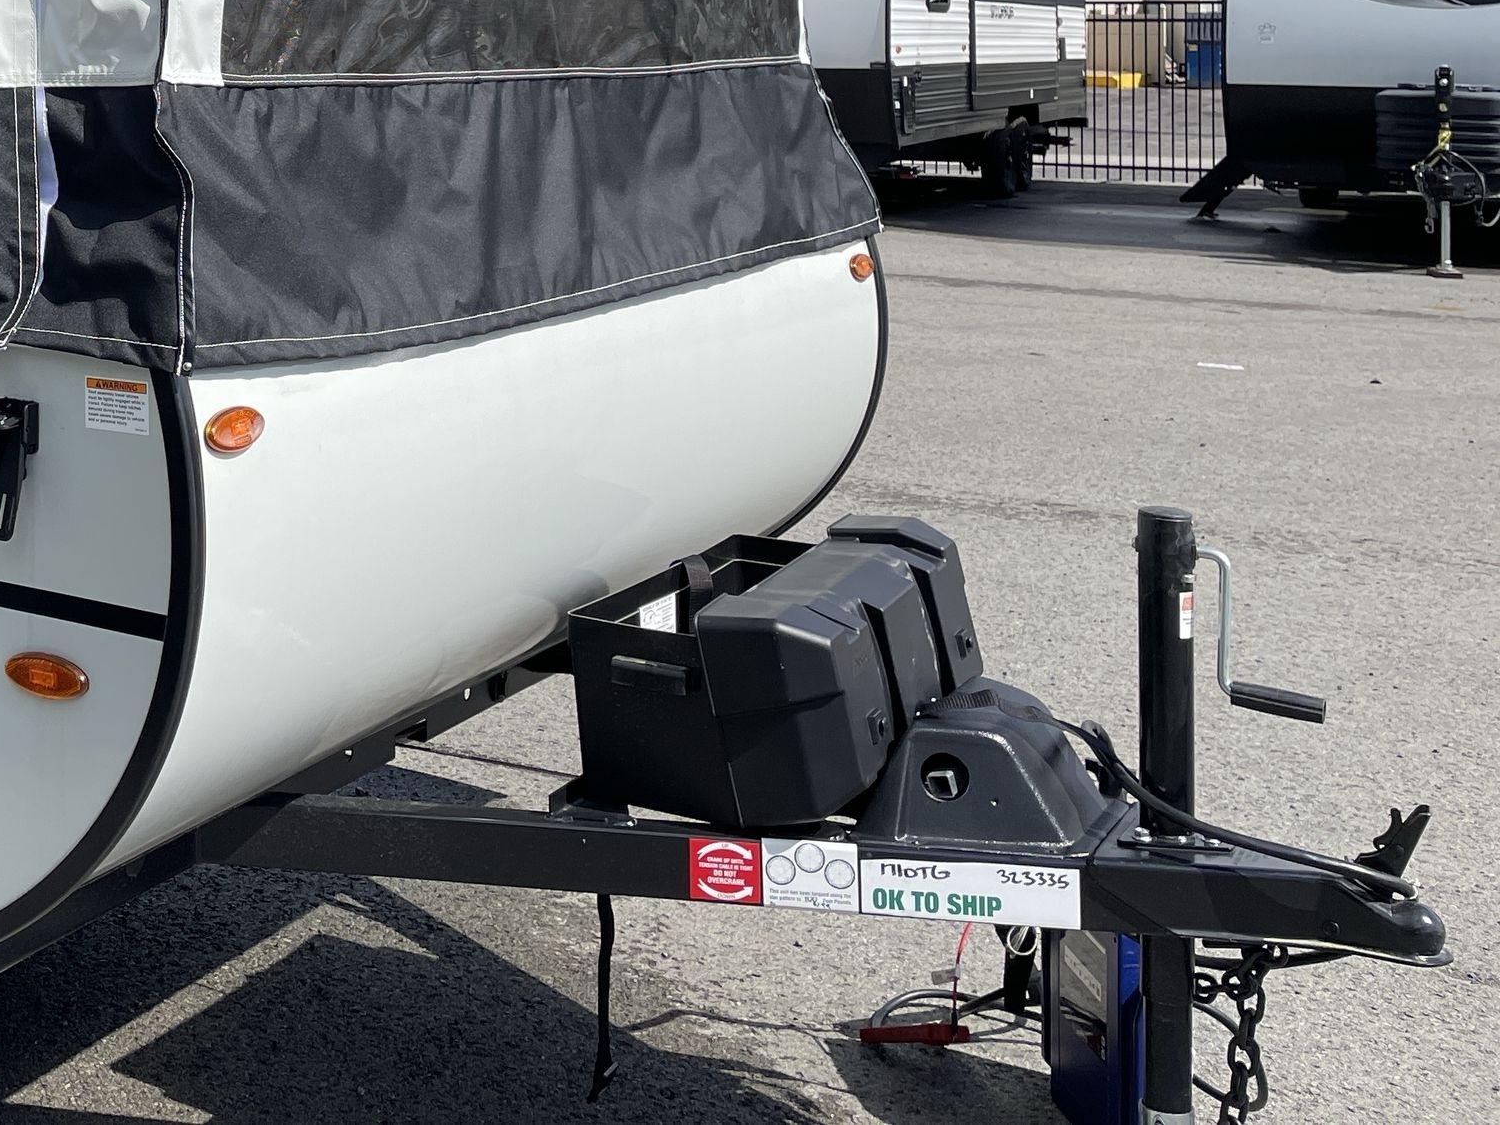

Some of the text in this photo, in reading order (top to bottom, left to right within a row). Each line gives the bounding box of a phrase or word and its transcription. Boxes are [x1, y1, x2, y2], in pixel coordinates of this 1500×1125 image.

[101, 381, 138, 392] WARNING
[723, 870, 737, 878] NOT
[996, 869, 1070, 889] 323335
[707, 876, 745, 886] OVERCRANK
[872, 887, 1002, 917] OK TO SHIP
